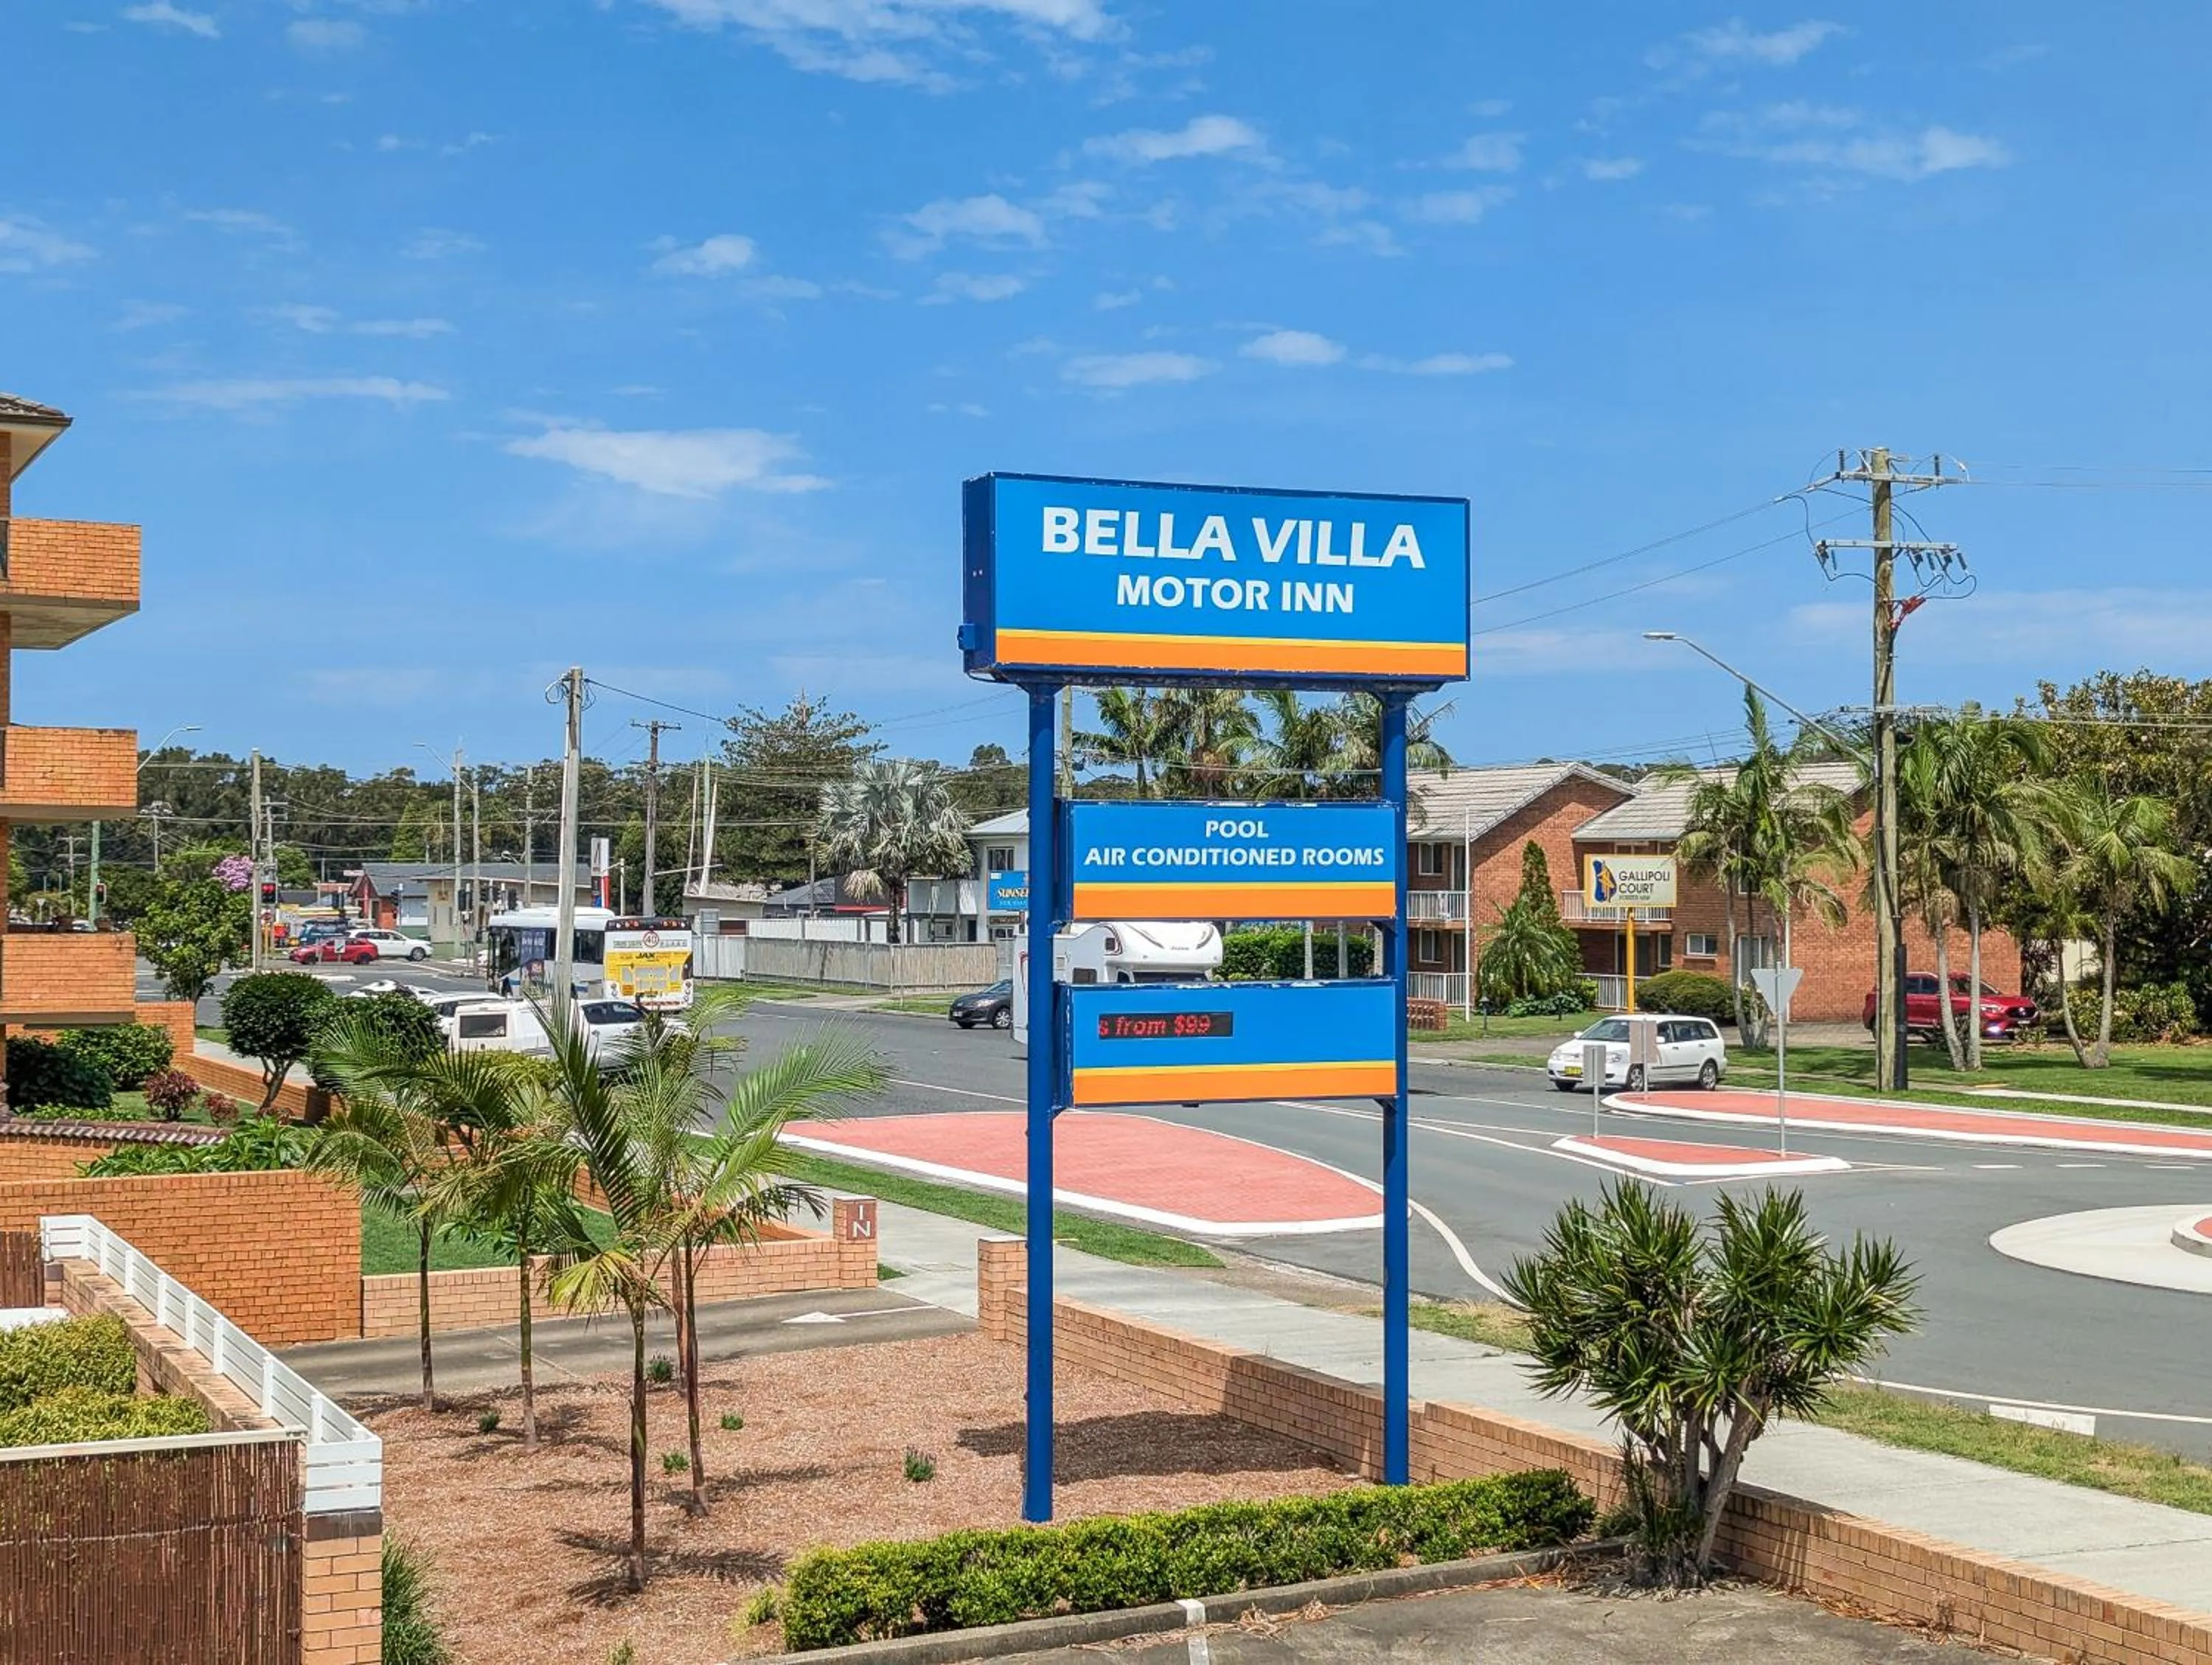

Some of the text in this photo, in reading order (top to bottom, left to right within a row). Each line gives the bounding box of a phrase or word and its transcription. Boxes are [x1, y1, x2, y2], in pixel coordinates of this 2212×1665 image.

[1043, 507, 1425, 569] BELLA VILLA
[1117, 574, 1354, 613] MOTOR INN
[1206, 820, 1269, 838] POOL
[1084, 847, 1384, 866] AIR CONDITIONED ROOMS
[1618, 871, 1670, 882] GALLIPOLI
[1618, 883, 1654, 894] COURT
[1115, 1016, 1166, 1036] from
[852, 1204, 871, 1238] IN
